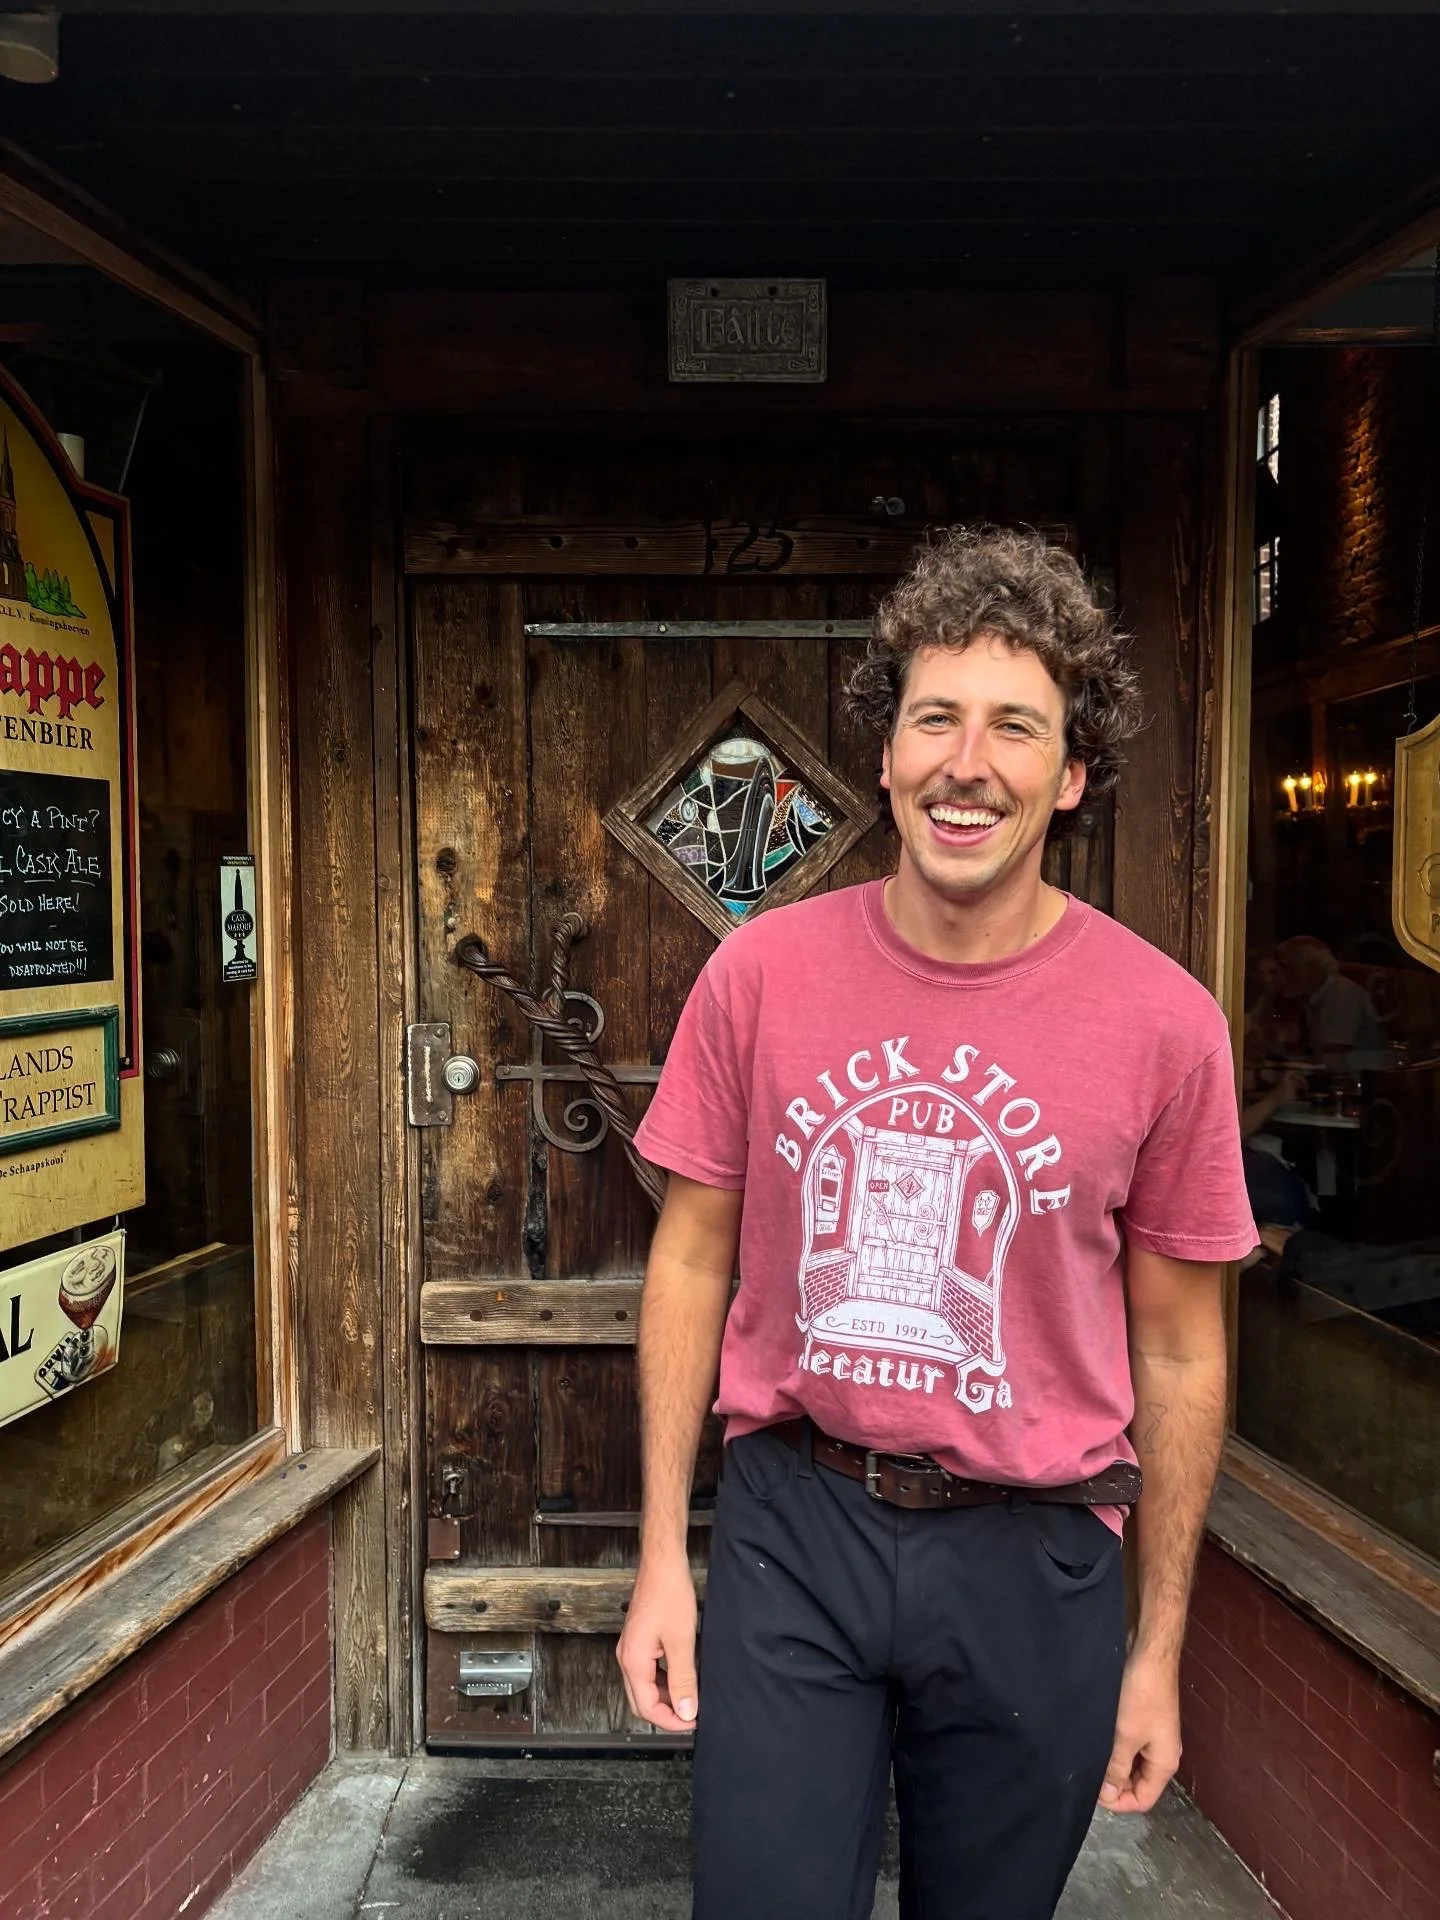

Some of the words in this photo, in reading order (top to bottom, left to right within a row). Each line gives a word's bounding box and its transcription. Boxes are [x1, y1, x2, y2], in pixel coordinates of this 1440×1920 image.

[0, 715, 94, 750] ENBIER
[31, 810, 41, 828] A
[46, 806, 100, 834] PINT?
[15, 845, 62, 878] CASK
[64, 848, 101, 879] ALE
[38, 892, 80, 914] HERE!
[227, 922, 252, 933] MARQUE
[231, 913, 247, 922] CASK
[0, 942, 14, 955] OU
[16, 939, 42, 954] WILL
[45, 938, 67, 951] NOT
[0, 1082, 96, 1124] RAPPIST
[887, 1097, 956, 1134] PUB
[775, 1035, 921, 1172] BRICK
[940, 1043, 1072, 1216] STORE
[869, 1181, 889, 1191] OPEN
[851, 1318, 885, 1333] ESTD
[894, 1323, 929, 1341] 1997
[953, 1351, 1013, 1414] Ga
